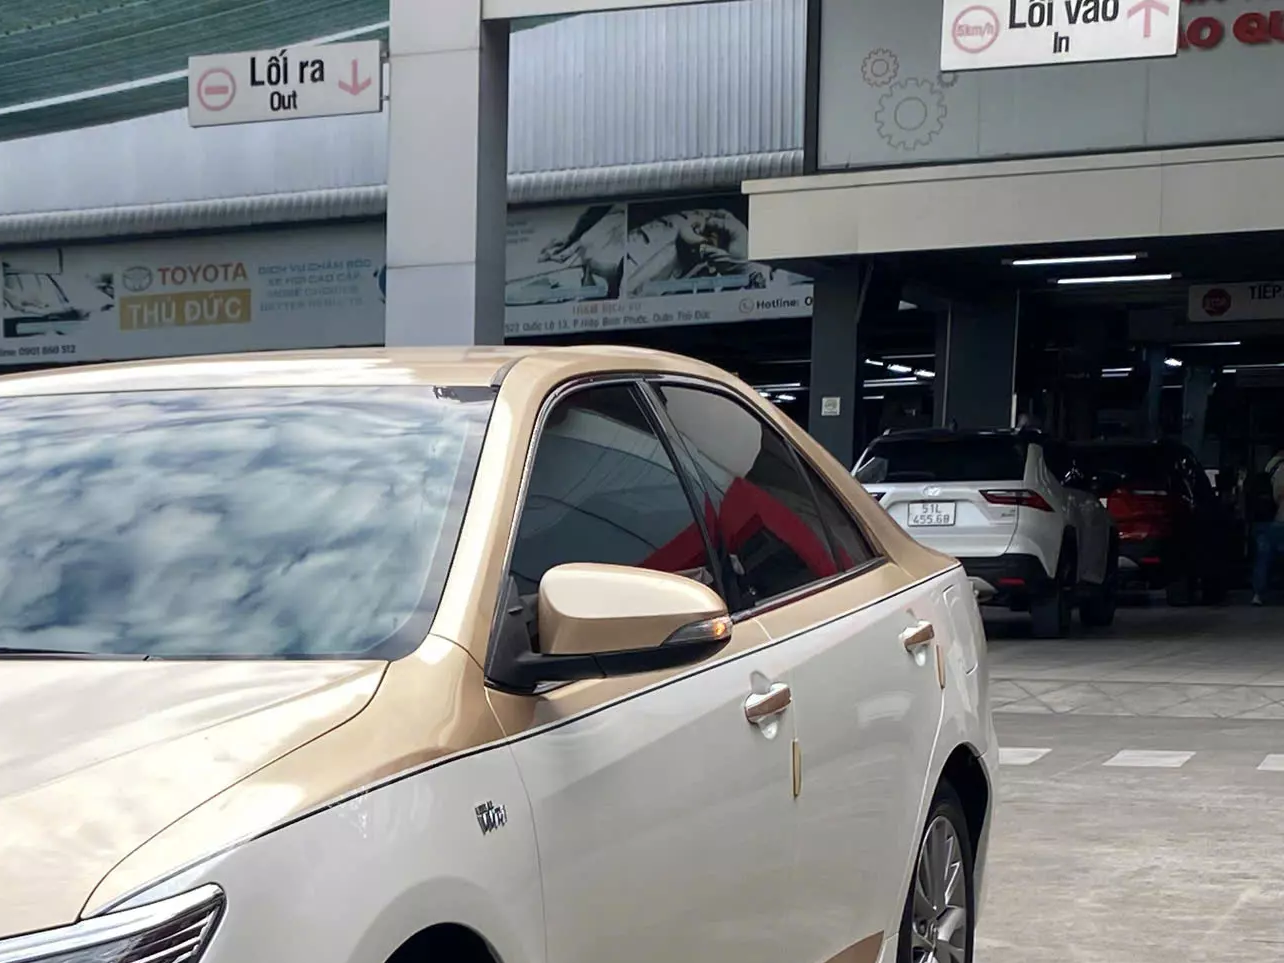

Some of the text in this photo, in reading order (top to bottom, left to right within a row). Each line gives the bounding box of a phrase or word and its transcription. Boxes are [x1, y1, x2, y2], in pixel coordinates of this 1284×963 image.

[1053, 32, 1070, 54] In
[250, 49, 325, 87] Lối ra
[270, 90, 298, 112] Out
[158, 262, 247, 286] TOYOTA
[126, 293, 242, 327] THỦ ĐỨC
[922, 503, 941, 514] 51L
